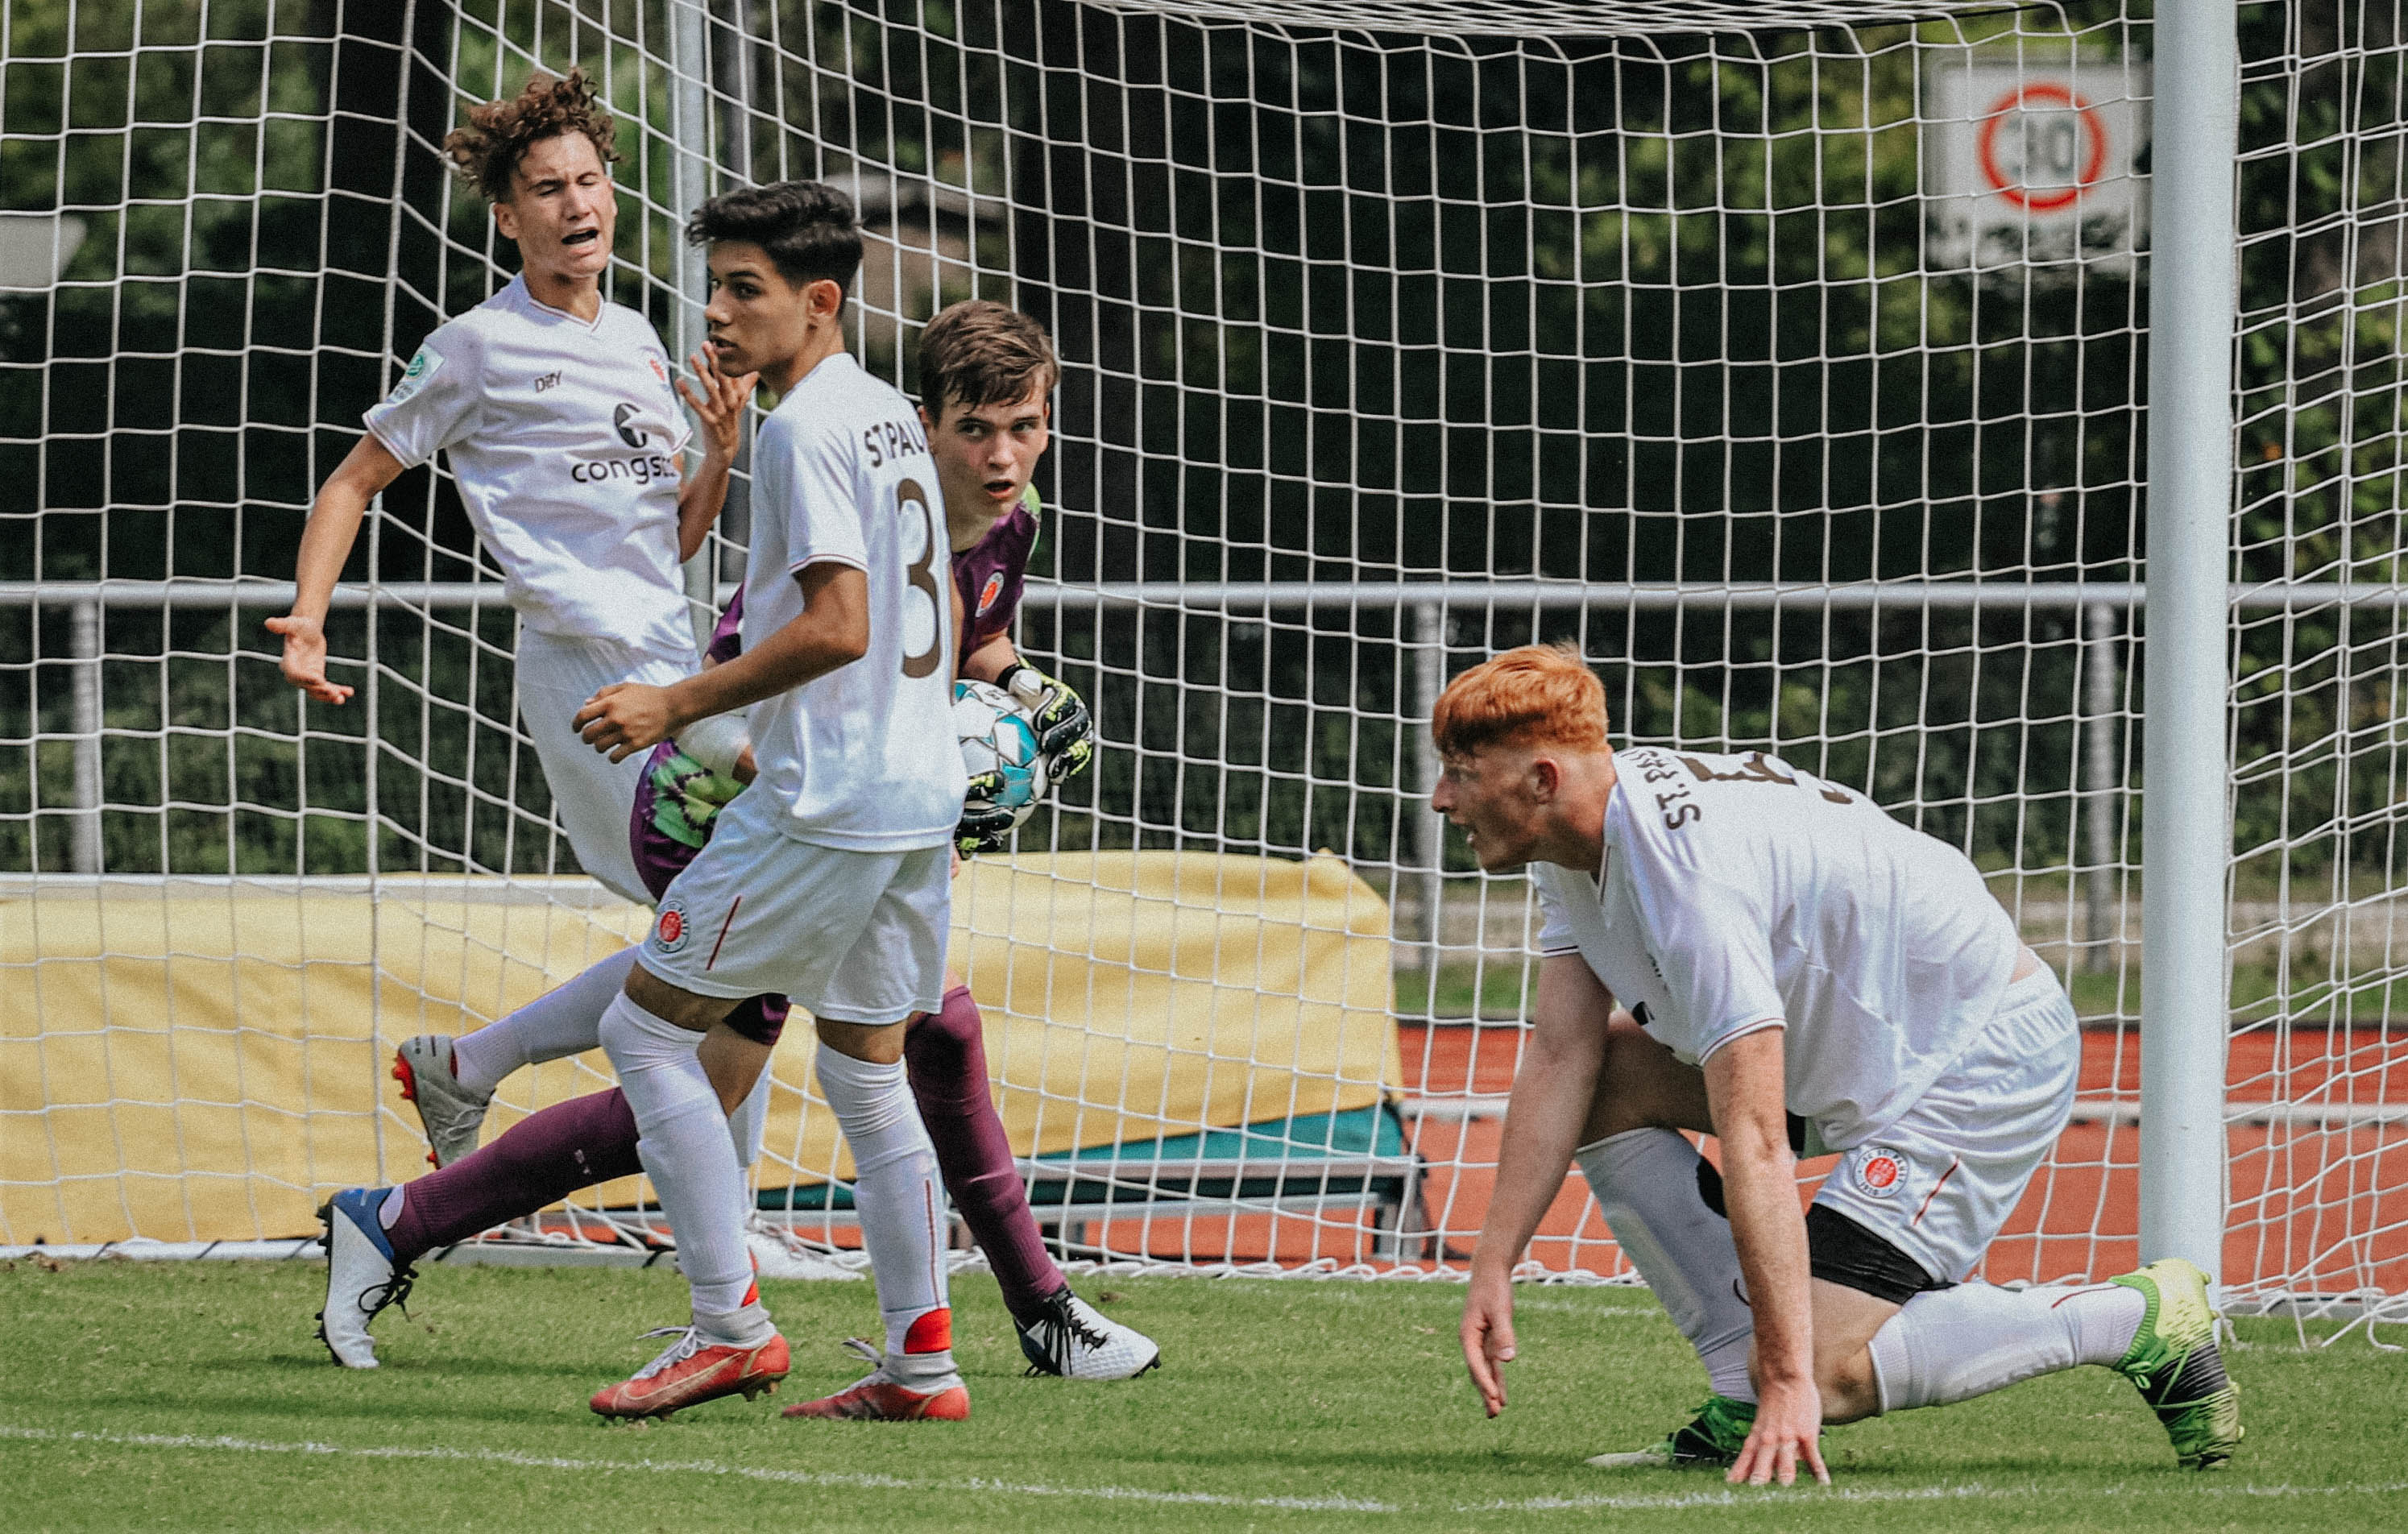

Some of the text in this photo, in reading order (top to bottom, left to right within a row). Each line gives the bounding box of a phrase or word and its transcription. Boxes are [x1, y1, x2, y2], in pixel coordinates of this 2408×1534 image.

[2006, 118, 2078, 176] 30
[885, 420, 927, 459] PAU
[571, 455, 676, 484] congs
[897, 478, 941, 678] 3
[1618, 748, 1701, 831] ST. PAU
